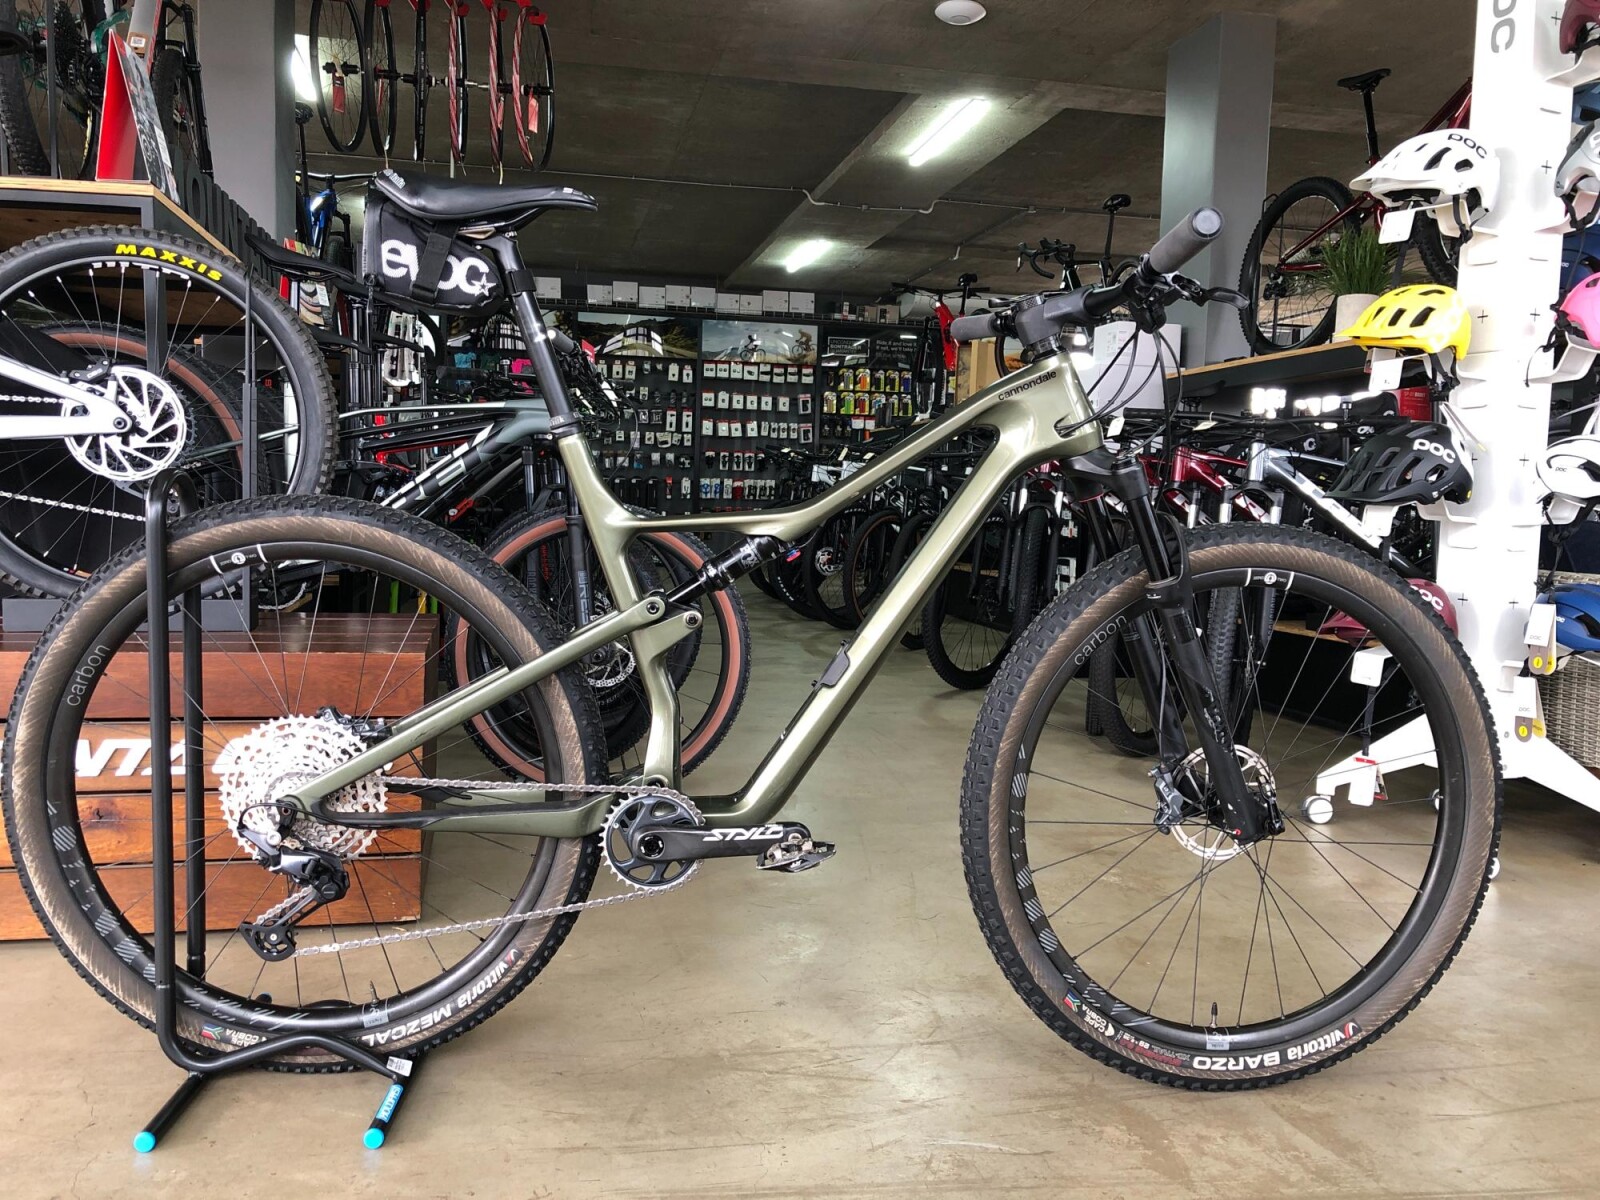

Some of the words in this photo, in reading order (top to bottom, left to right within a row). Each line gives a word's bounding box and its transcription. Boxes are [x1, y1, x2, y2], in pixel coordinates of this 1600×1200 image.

[1448, 133, 1488, 159] POC
[115, 243, 223, 282] MAXXIS
[998, 370, 1057, 401] cannondale
[1412, 438, 1456, 464] POC
[1410, 585, 1444, 611] OC
[1073, 613, 1128, 666] carbon
[65, 643, 111, 707] carbon
[703, 825, 784, 842] STYLO
[457, 961, 510, 1008] vittoria
[361, 1004, 452, 1047] MEZCAL
[1082, 1003, 1107, 1027] COBRA
[1084, 1014, 1105, 1033] CAPE
[1287, 1029, 1346, 1061] vittoria
[1192, 1050, 1281, 1071] BARZO
